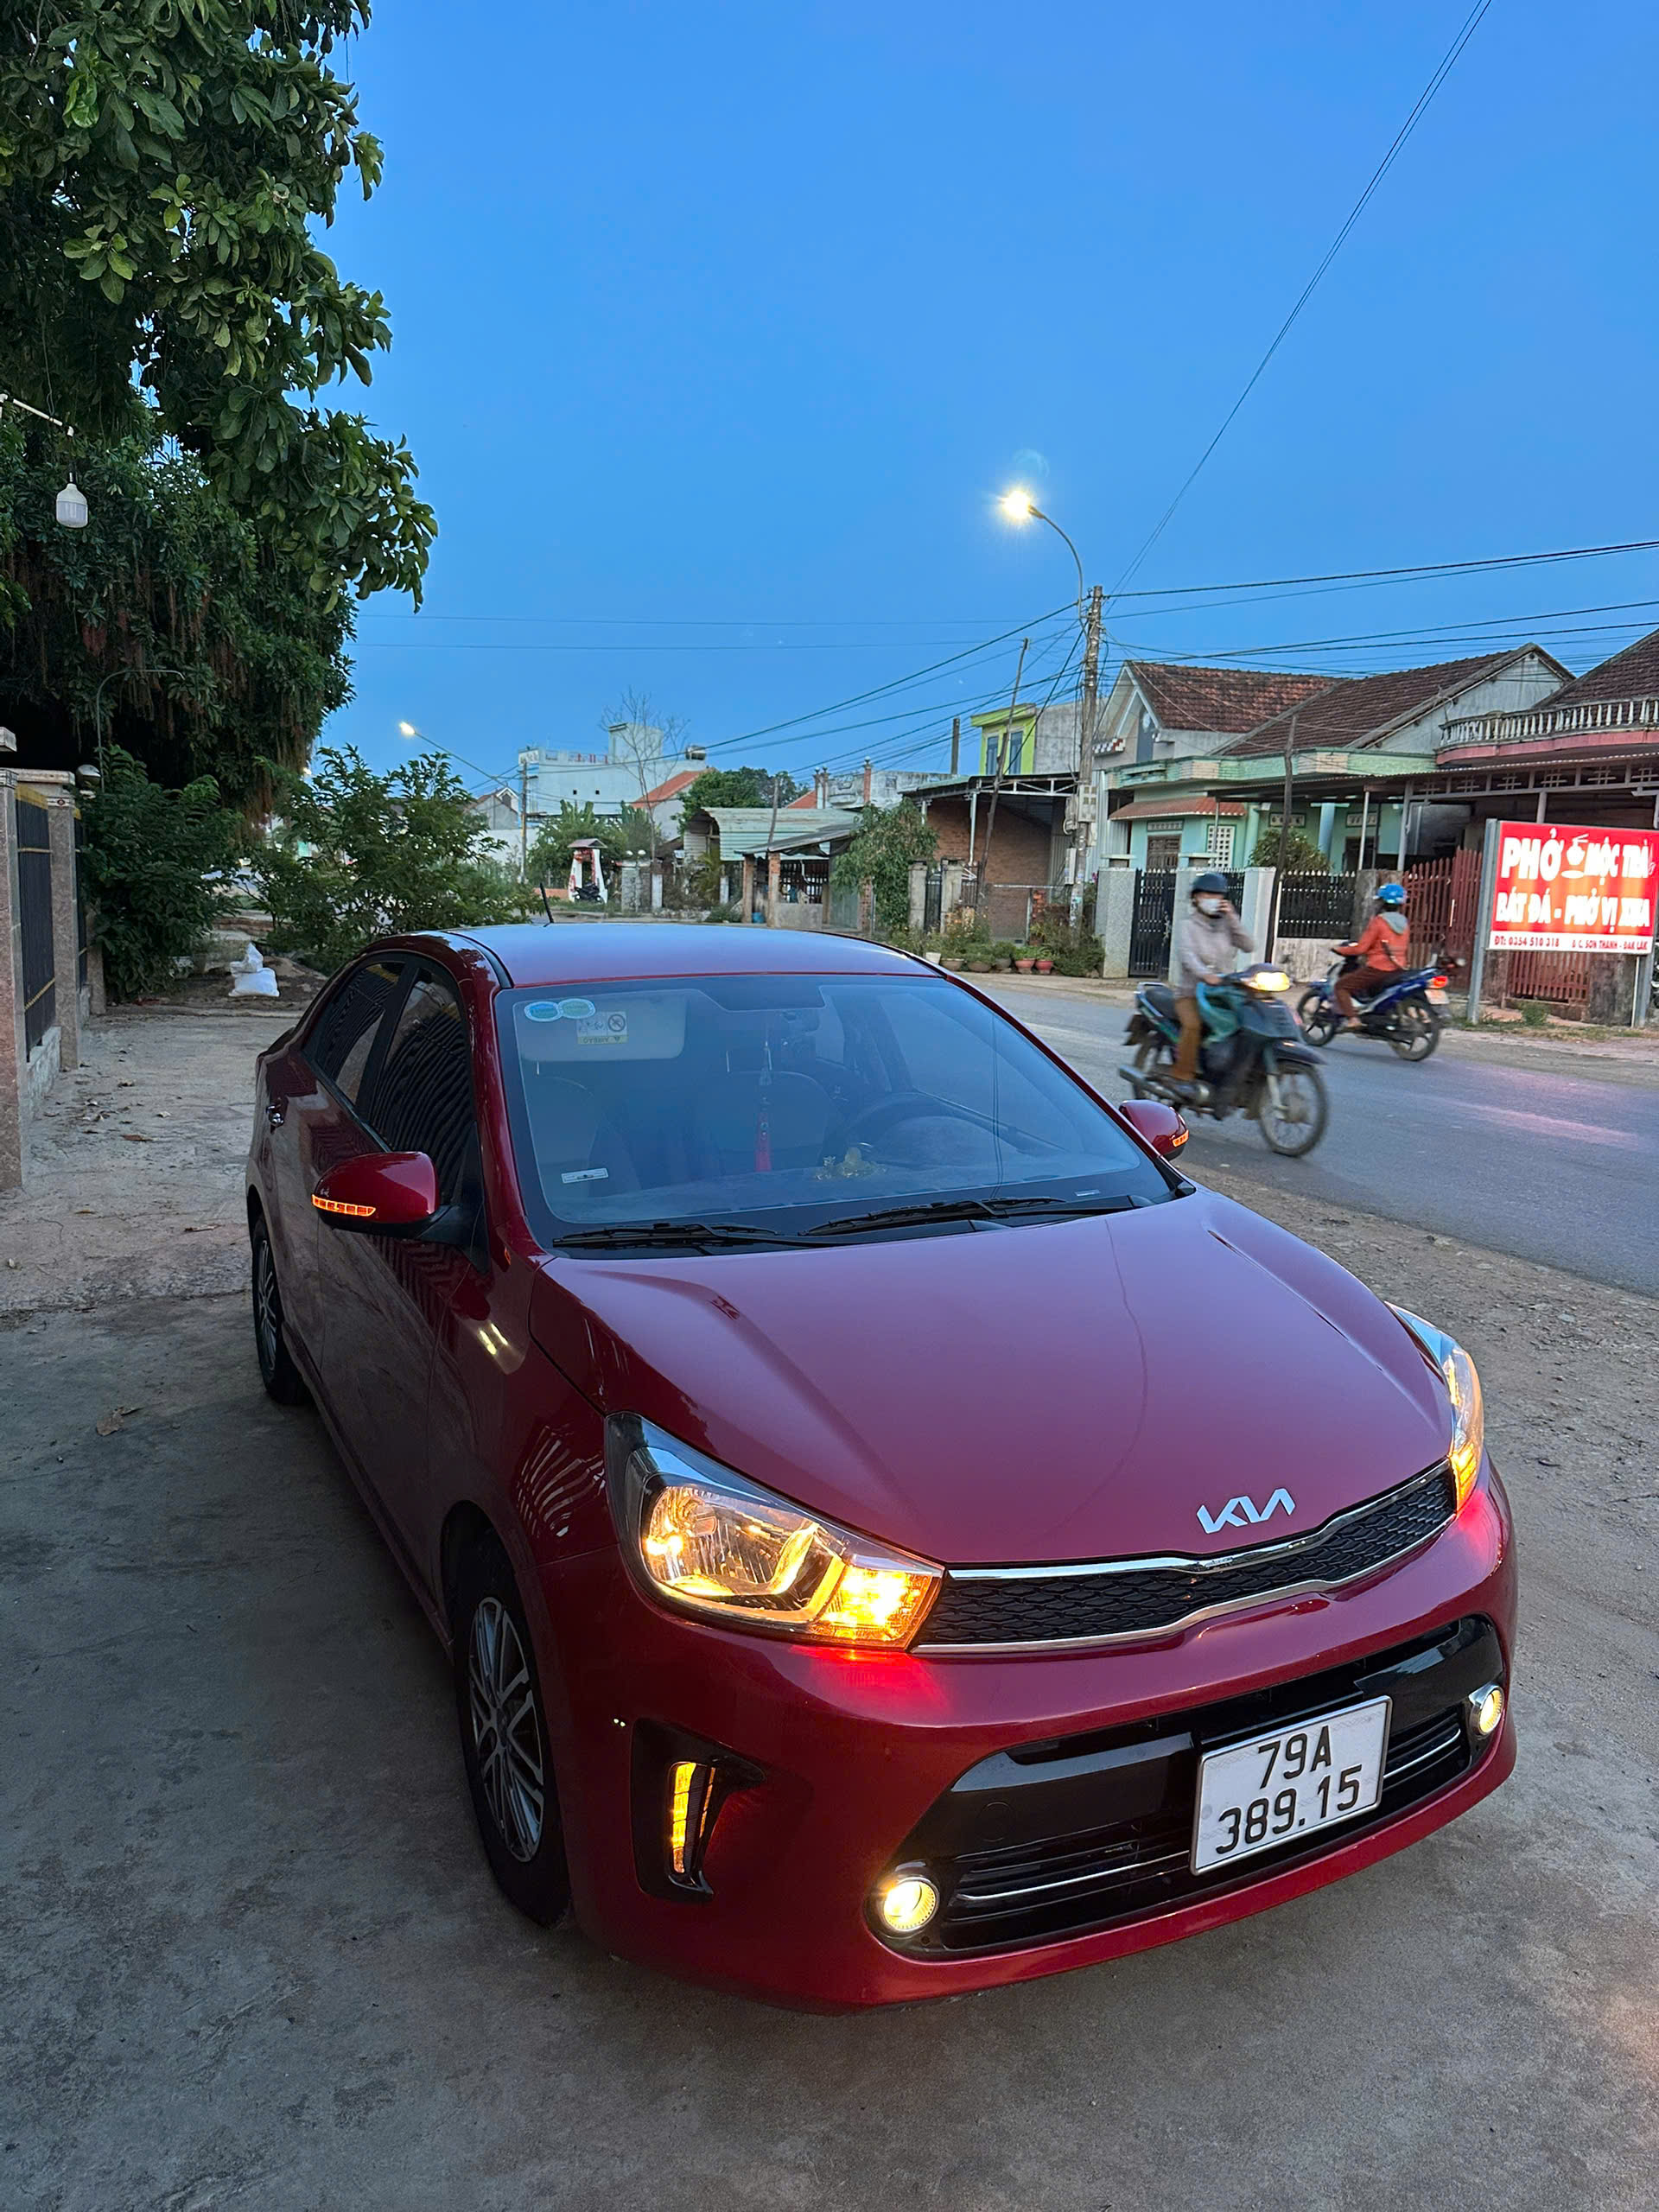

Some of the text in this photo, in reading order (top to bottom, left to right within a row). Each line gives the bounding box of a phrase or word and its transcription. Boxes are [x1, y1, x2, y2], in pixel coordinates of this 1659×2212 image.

[1501, 828, 1564, 881] PHỞ
[1584, 836, 1620, 885] MỘC
[1496, 887, 1528, 923] BÁT
[1528, 888, 1551, 924] ĐÁ
[1564, 888, 1599, 925] PHỞ
[1601, 896, 1618, 933] VỊ
[1196, 1488, 1295, 1534] KIA
[1257, 1726, 1332, 1789] 79A
[1216, 1764, 1363, 1855] 389.15
